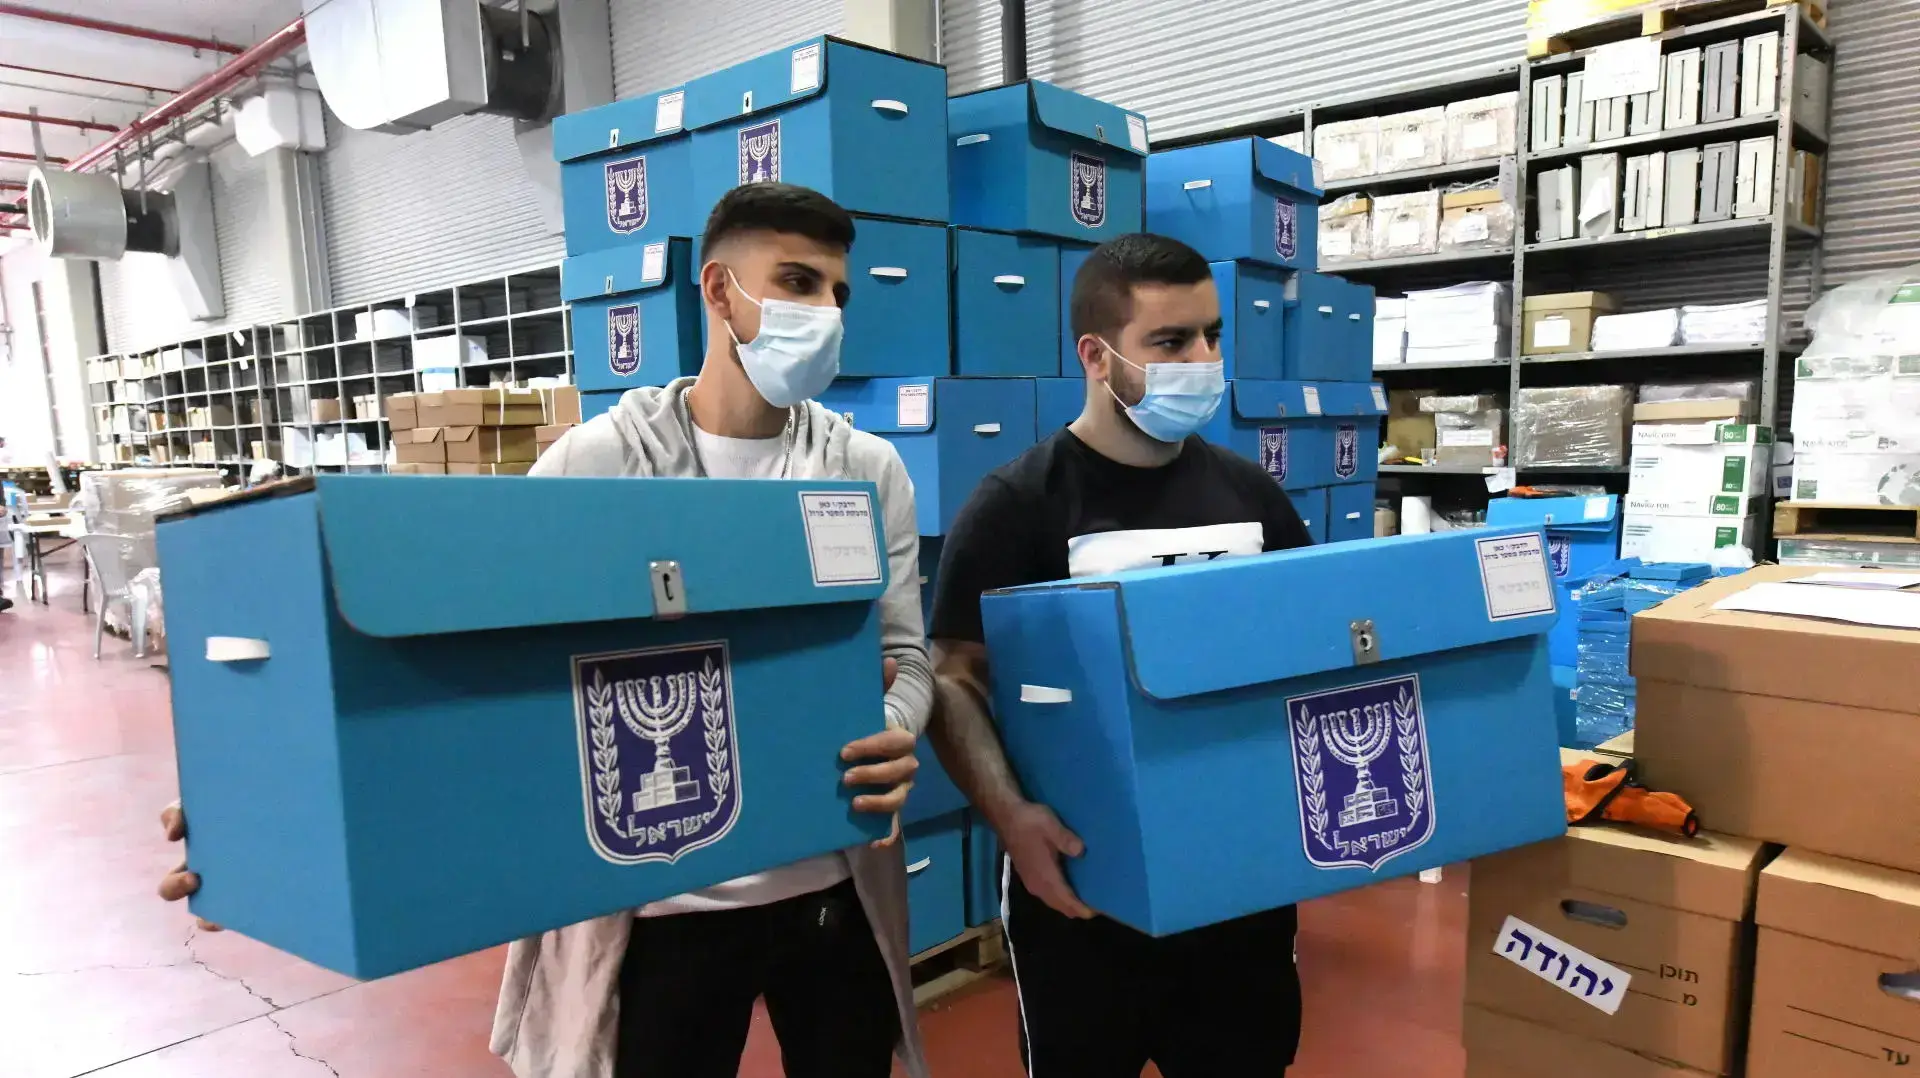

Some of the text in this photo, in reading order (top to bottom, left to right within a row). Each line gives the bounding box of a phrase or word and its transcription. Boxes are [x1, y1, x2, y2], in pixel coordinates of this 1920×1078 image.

[1724, 431, 1734, 440] 80
[1715, 503, 1726, 512] 80
[627, 811, 711, 848] ישראל
[1332, 827, 1407, 858] ישראל
[1504, 928, 1614, 997] יהודה
[1659, 962, 1699, 984] תוכן
[1682, 992, 1698, 1006] מ
[1880, 1046, 1910, 1066] עד
